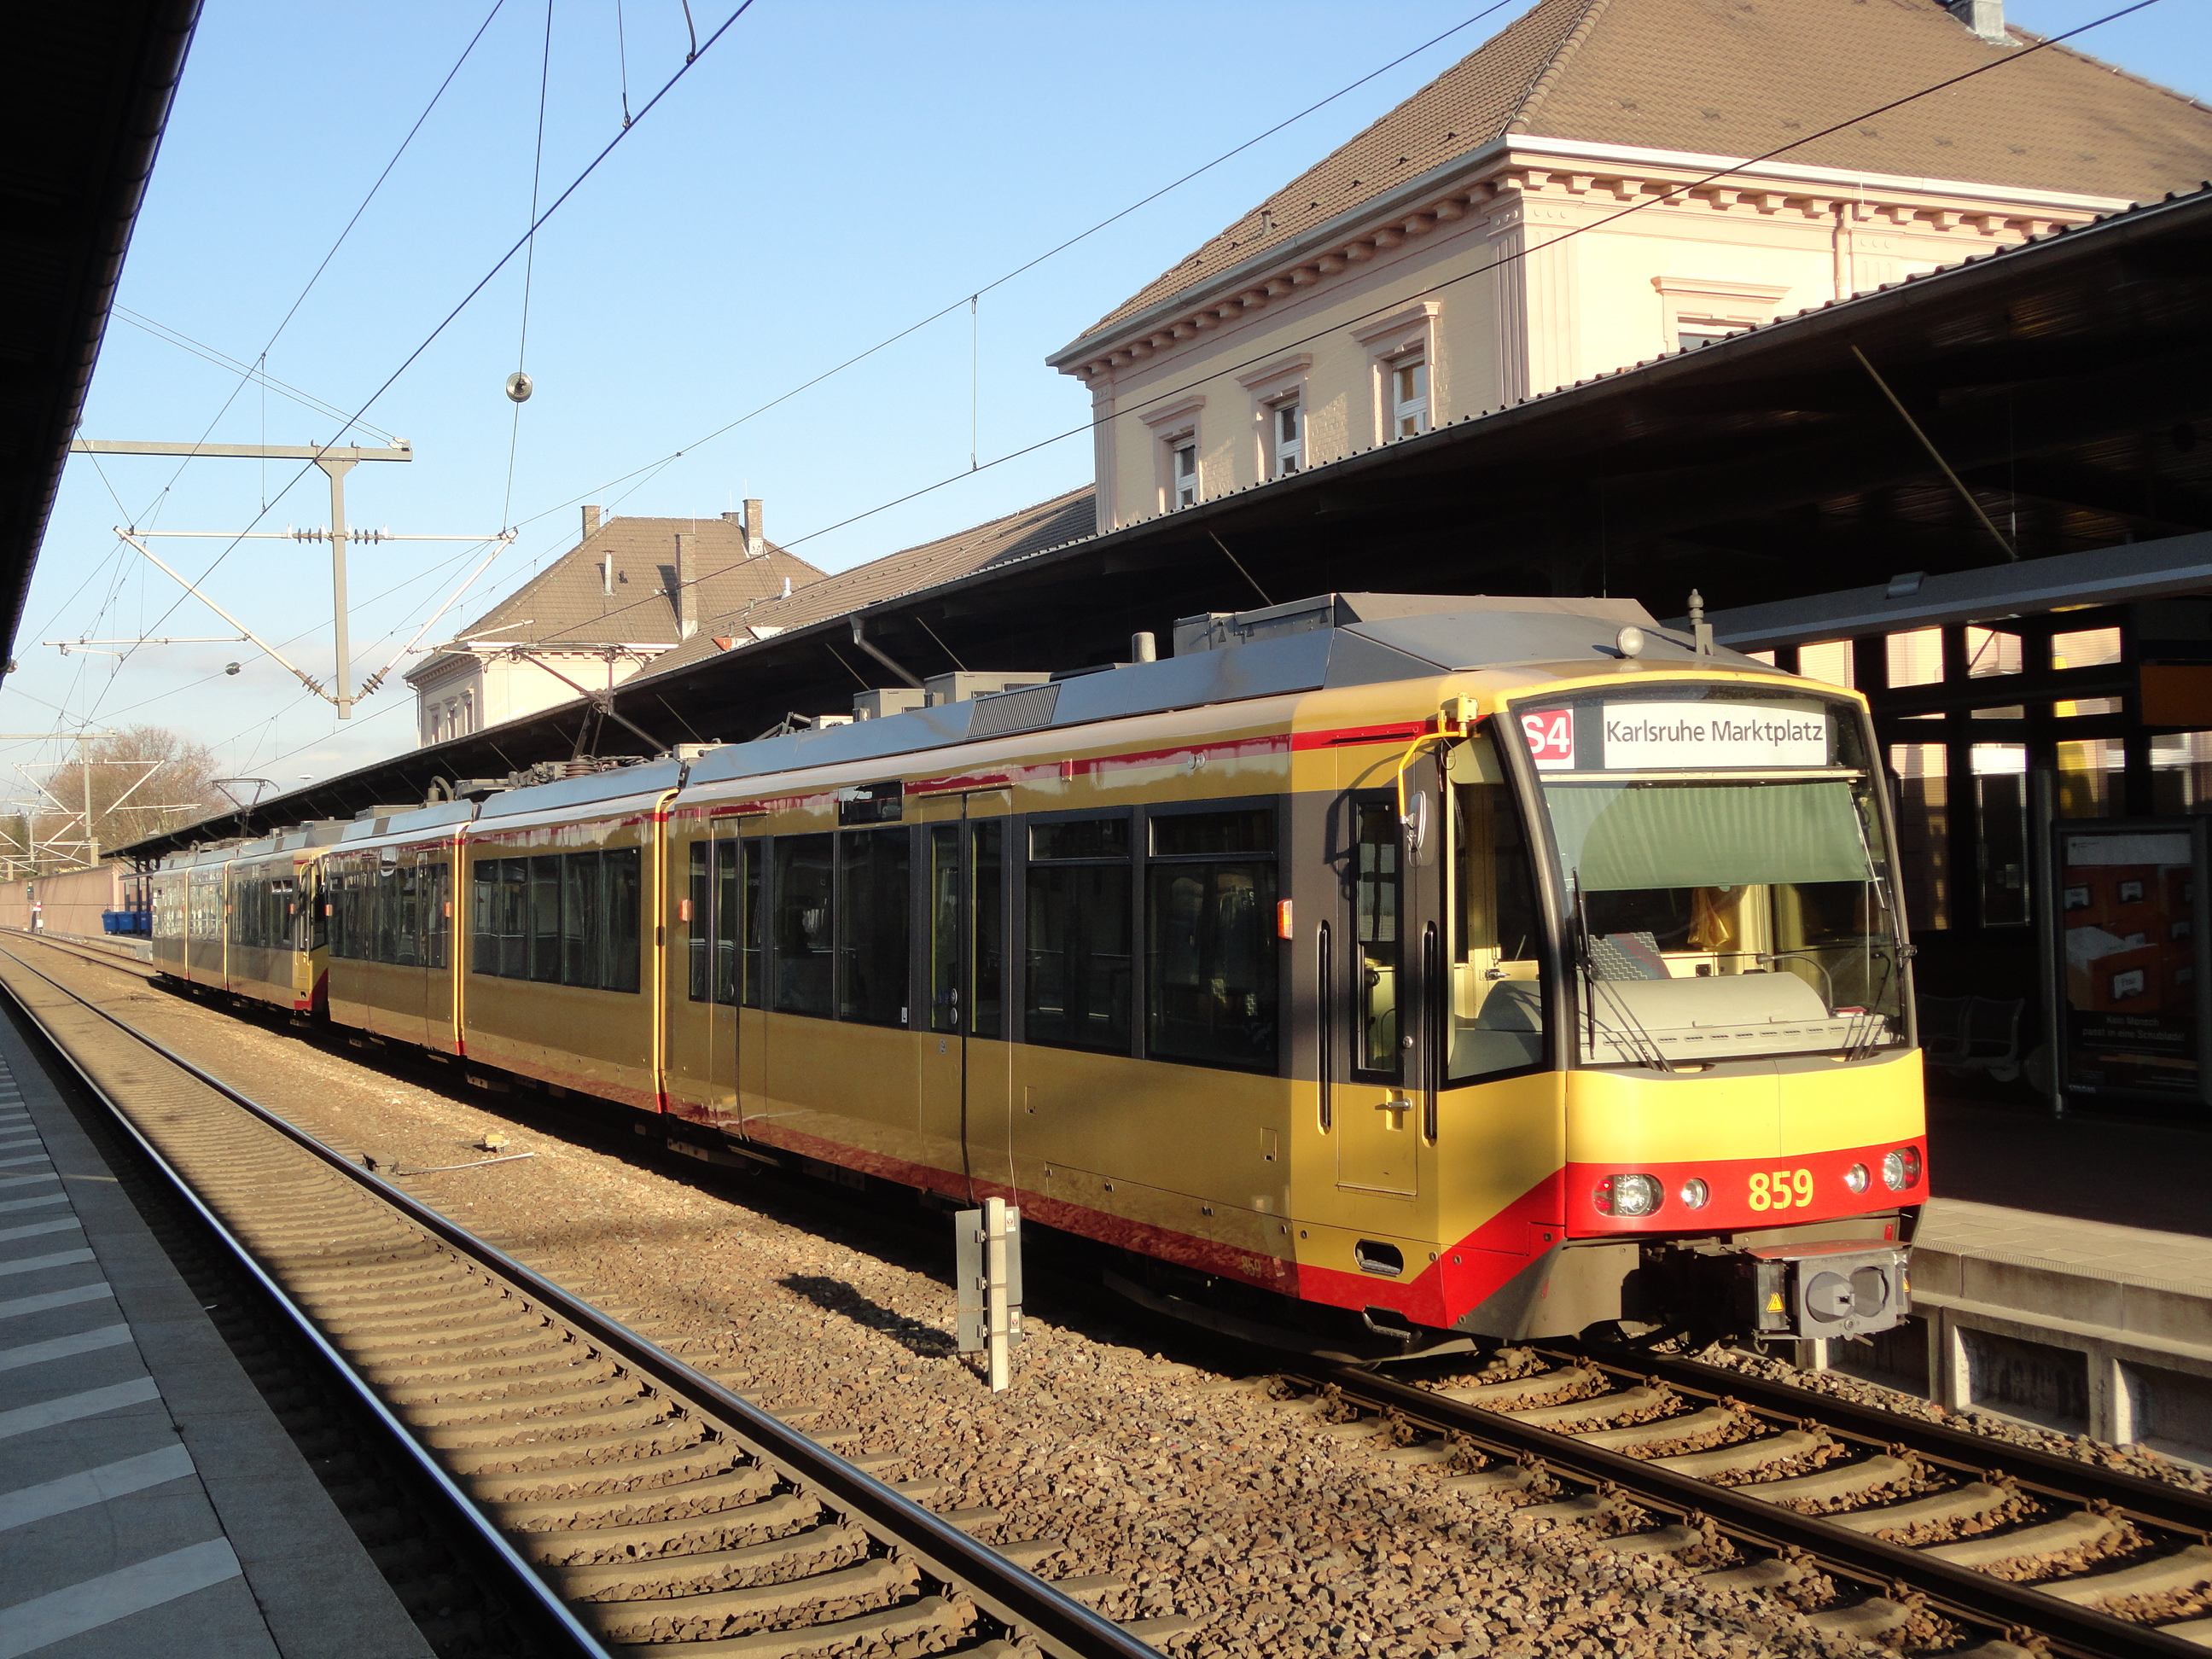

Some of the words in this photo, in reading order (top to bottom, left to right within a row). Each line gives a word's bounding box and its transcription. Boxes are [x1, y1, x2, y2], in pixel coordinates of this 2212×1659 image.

[1522, 716, 1569, 754] S4
[1606, 719, 1705, 742] Karlsruhe
[1712, 719, 1824, 747] Marktplatz
[2106, 1016, 2125, 1026] Kein
[2127, 1016, 2159, 1027] Mensch
[2082, 1028, 2105, 1038] passt
[2118, 1029, 2135, 1039] eine
[2137, 1030, 2185, 1042] Schublade!
[1748, 1168, 1814, 1212] 859
[1241, 1255, 1261, 1278] 859
